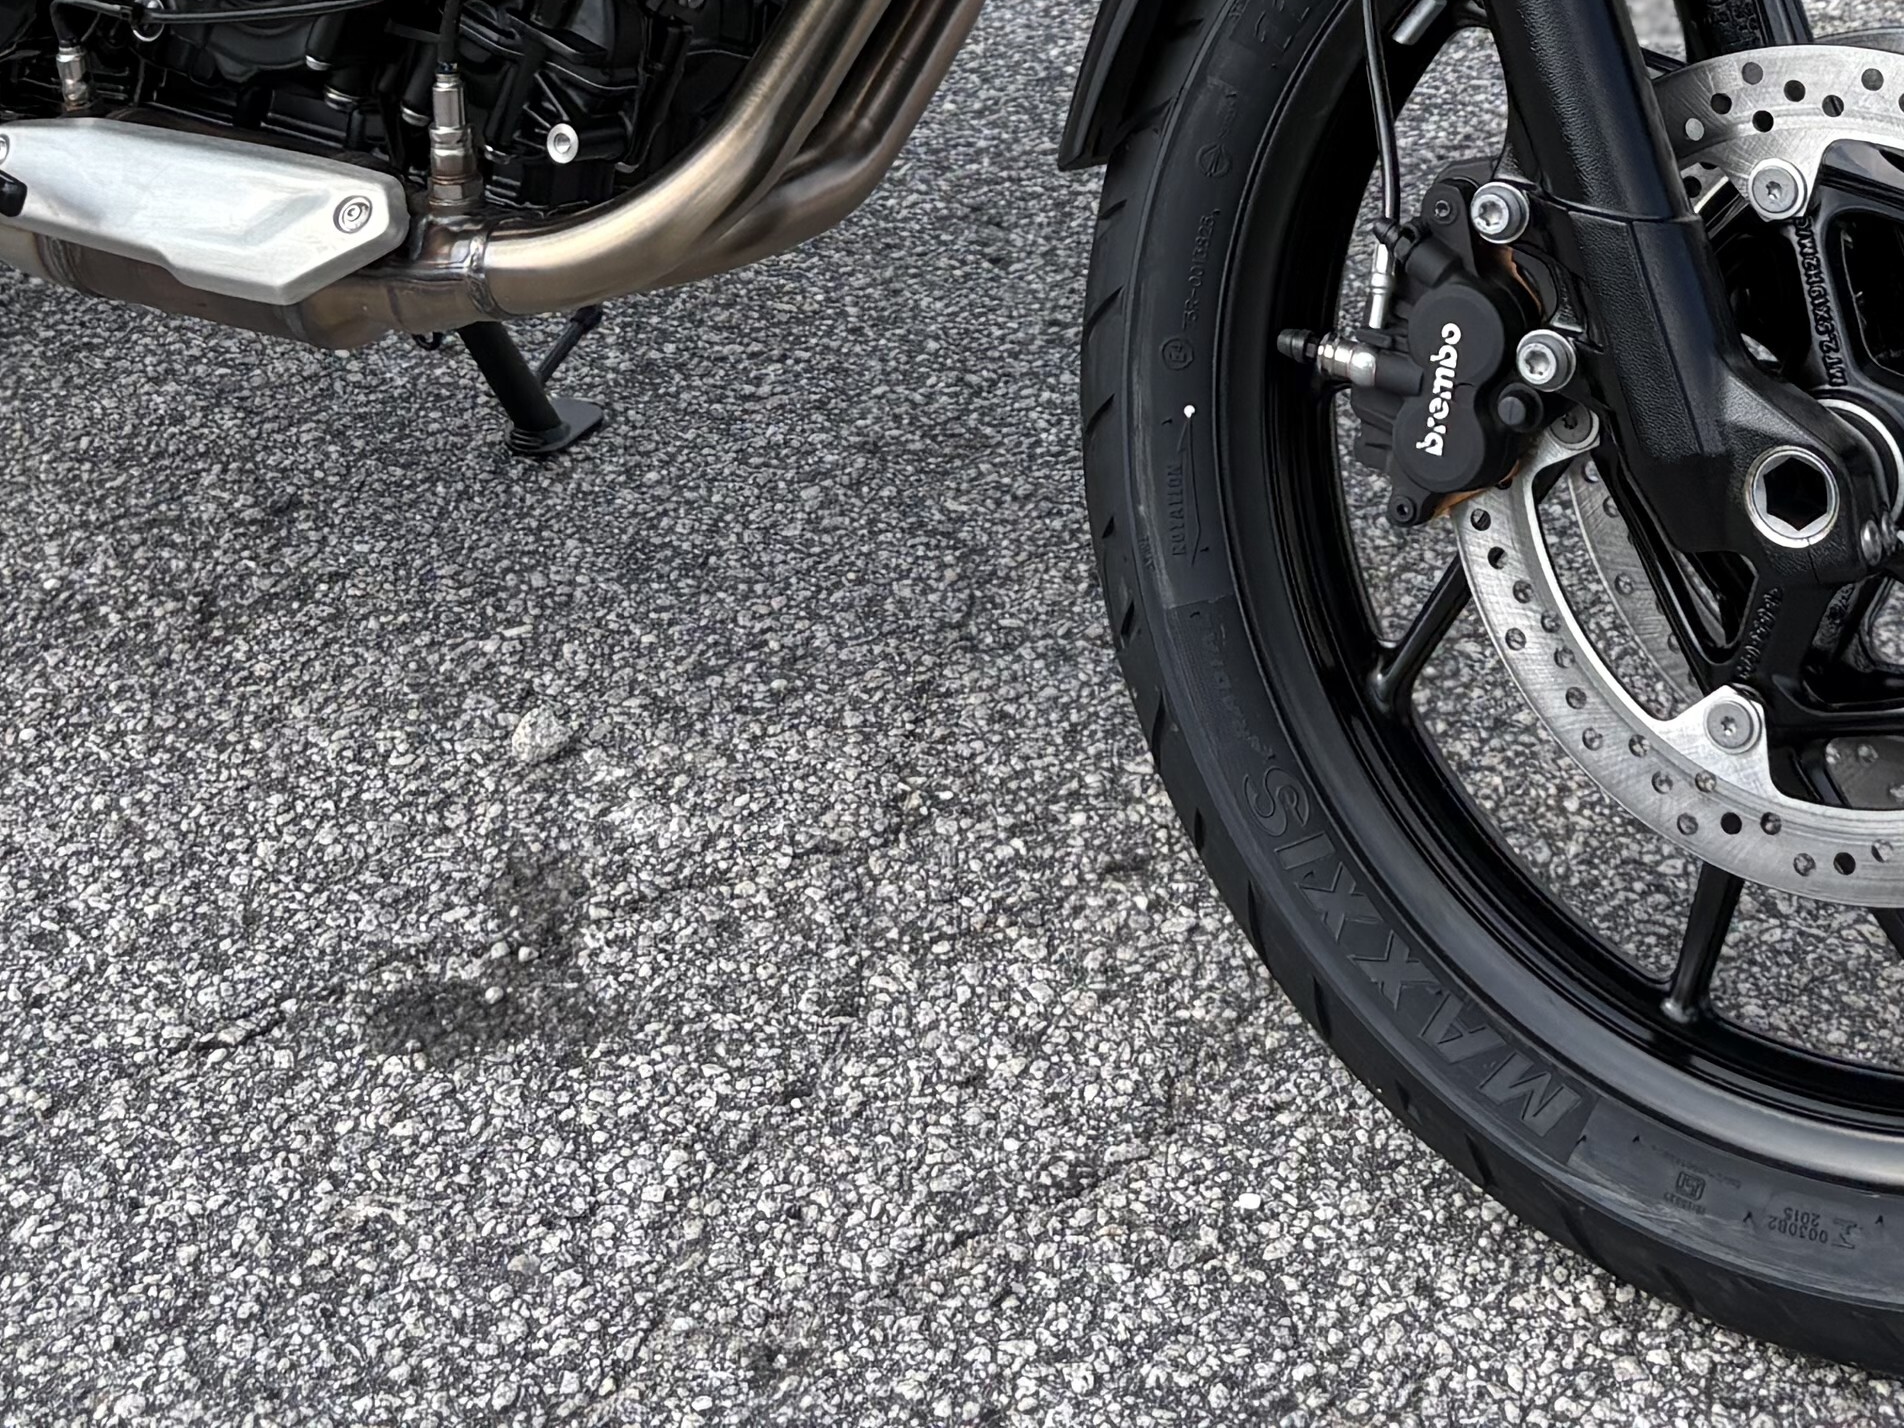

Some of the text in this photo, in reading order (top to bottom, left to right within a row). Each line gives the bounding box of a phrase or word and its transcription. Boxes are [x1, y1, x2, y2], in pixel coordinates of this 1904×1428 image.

[1415, 321, 1461, 457] brembo
[1243, 765, 1584, 1141] MAXXIS
[1783, 1205, 1821, 1227] 2015
